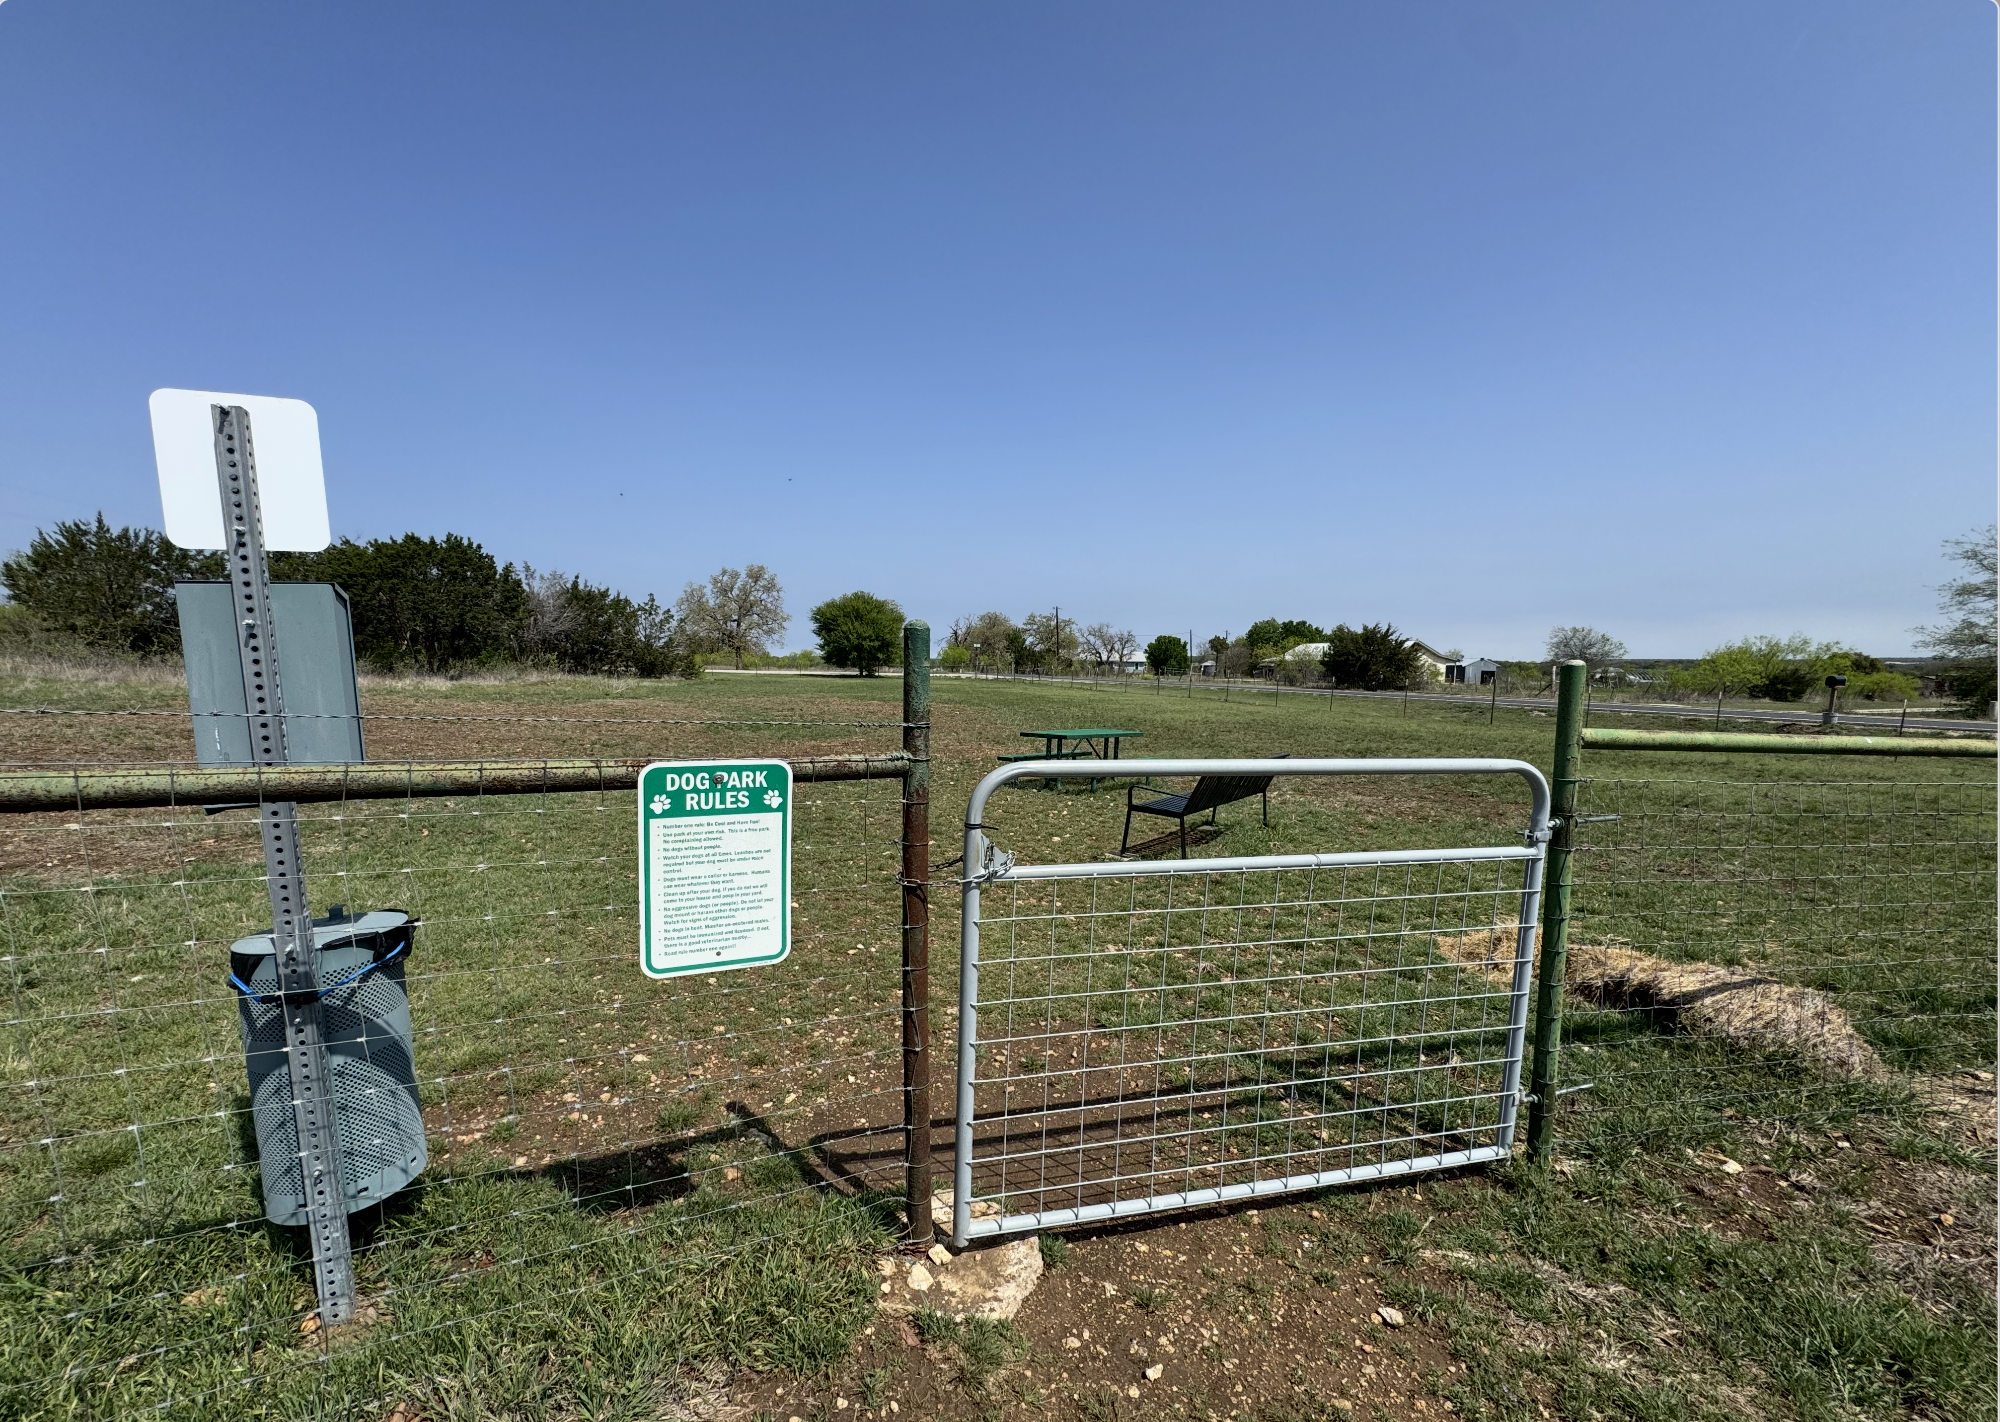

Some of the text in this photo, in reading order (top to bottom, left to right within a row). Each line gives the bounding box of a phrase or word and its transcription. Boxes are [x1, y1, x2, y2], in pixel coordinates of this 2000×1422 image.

[666, 771, 768, 791] DOG PARK
[686, 791, 749, 810] RULES
